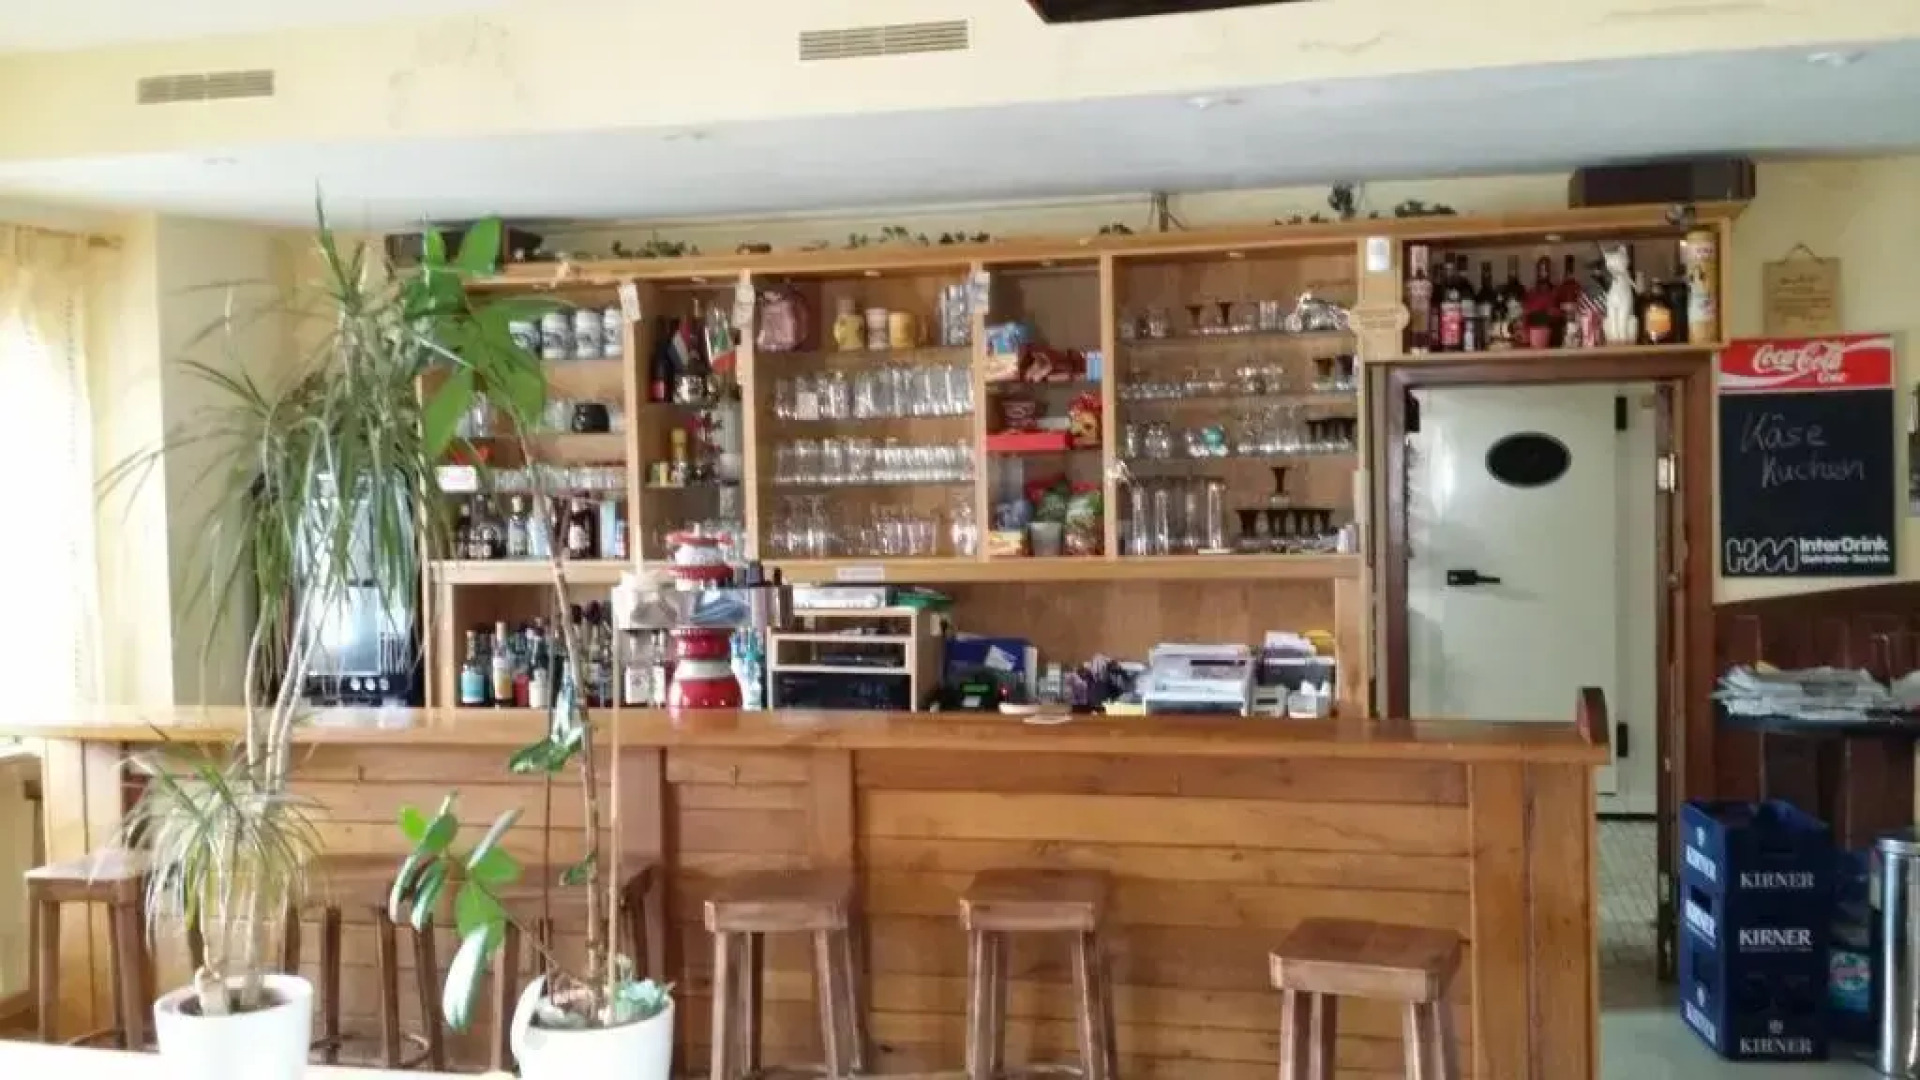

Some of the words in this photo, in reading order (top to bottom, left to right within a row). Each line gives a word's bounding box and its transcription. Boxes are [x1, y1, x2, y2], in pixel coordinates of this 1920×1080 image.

[1800, 536, 1889, 552] InterDrink
[1740, 872, 1815, 889] KIRNER
[1739, 928, 1812, 946] KIRNER
[1740, 1037, 1812, 1054] KIRNER
